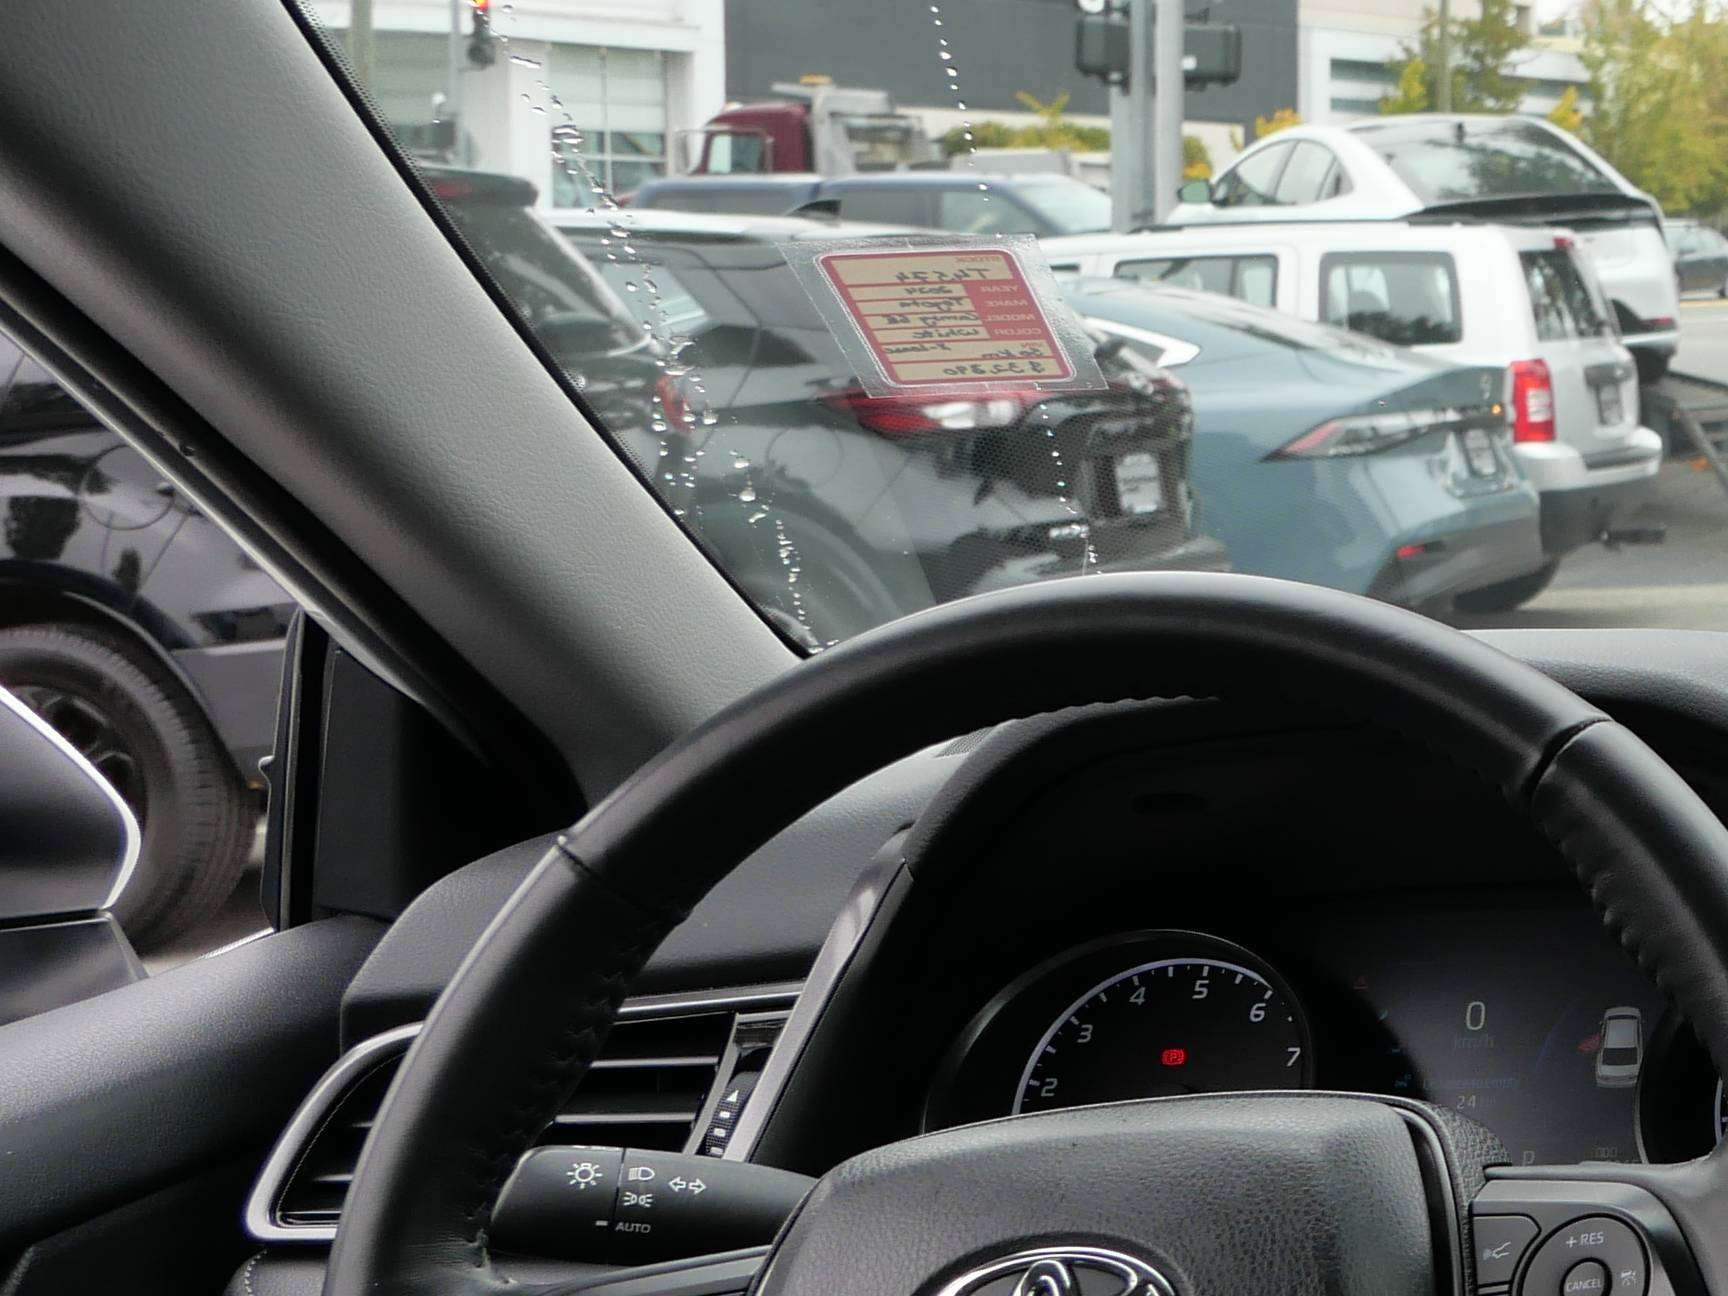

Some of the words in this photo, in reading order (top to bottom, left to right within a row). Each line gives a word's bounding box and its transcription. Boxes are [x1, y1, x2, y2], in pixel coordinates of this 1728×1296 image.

[1128, 987, 1147, 1005] 4
[1192, 979, 1210, 1000] 5
[1249, 1002, 1267, 1022] 6
[1464, 1000, 1487, 1032] 0
[1076, 1023, 1093, 1044] 3
[1285, 1047, 1301, 1067] 7
[1040, 1078, 1059, 1098] 2
[615, 1221, 652, 1234] AUTO
[1580, 1231, 1605, 1245] RES
[1566, 1279, 1602, 1292] CANCEL
